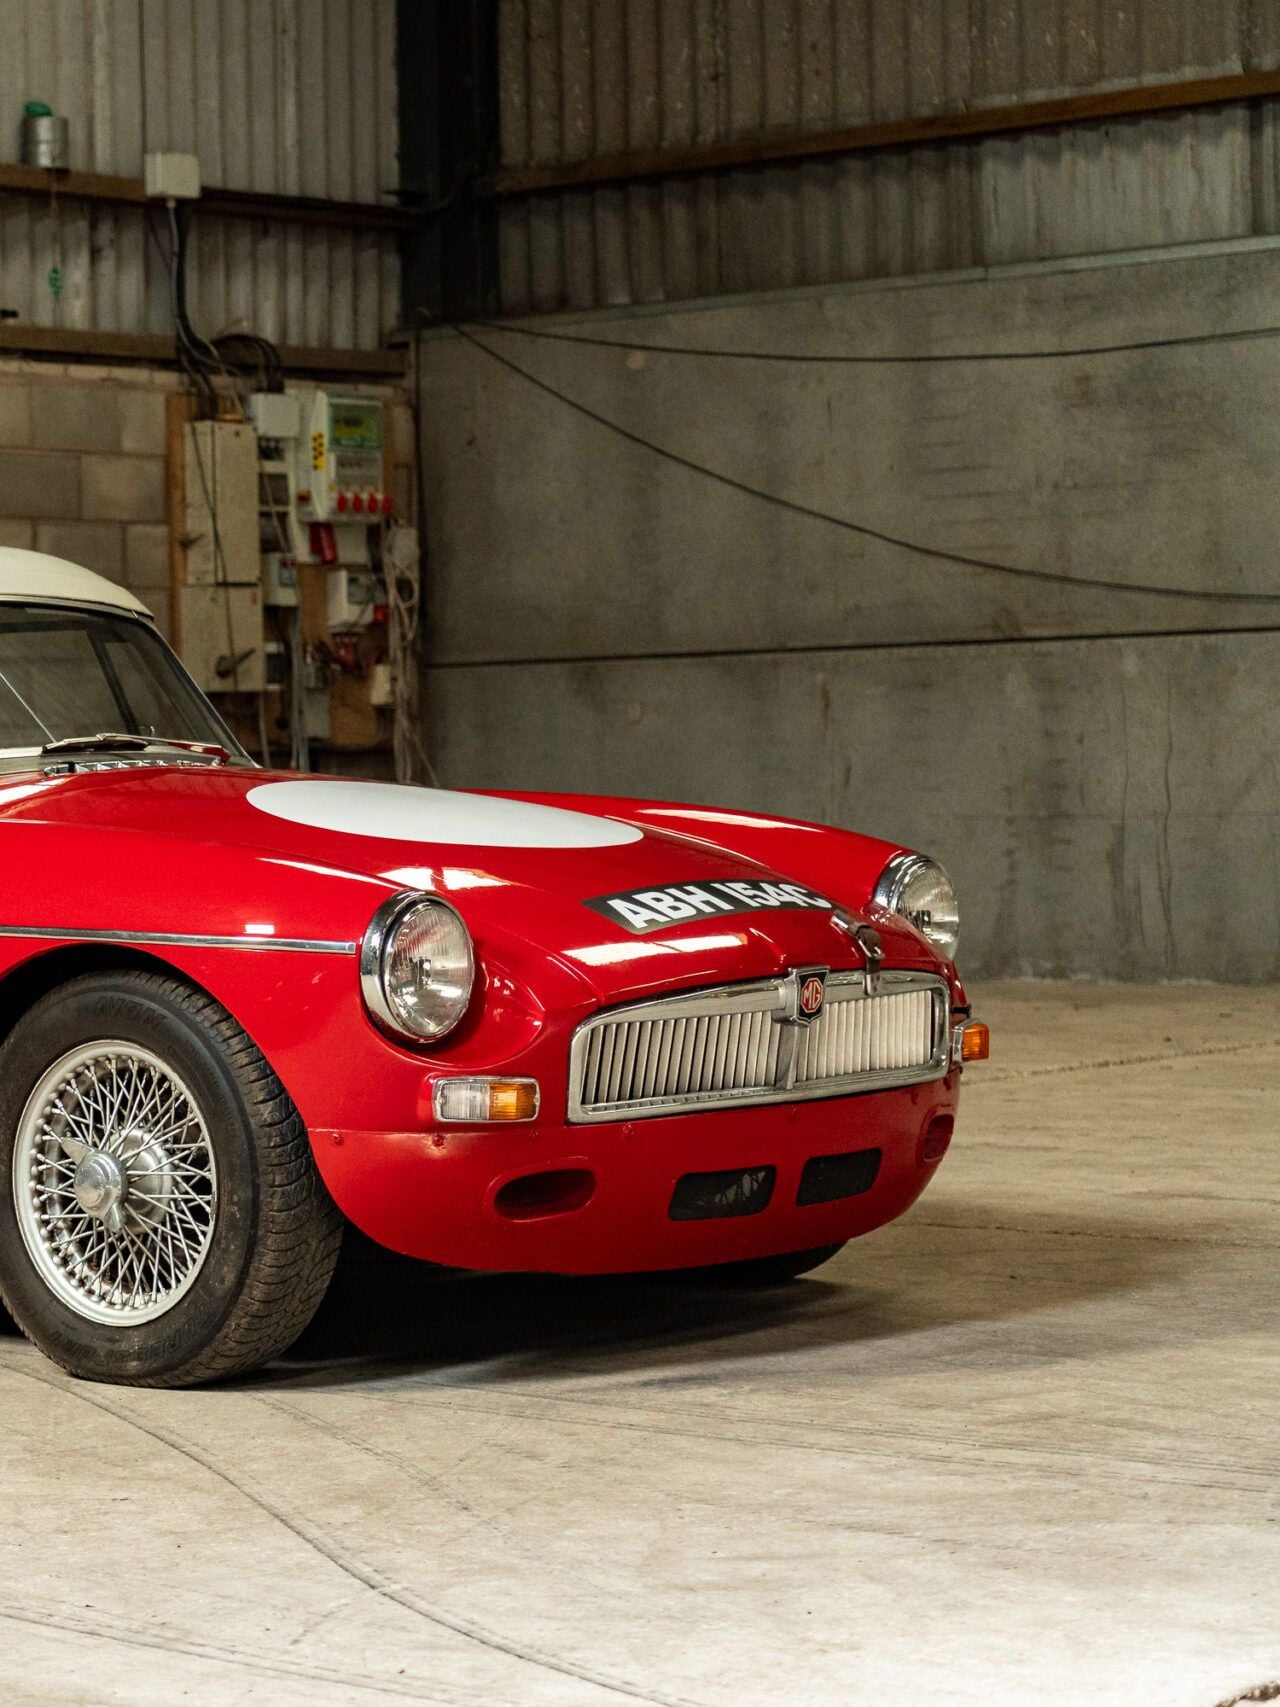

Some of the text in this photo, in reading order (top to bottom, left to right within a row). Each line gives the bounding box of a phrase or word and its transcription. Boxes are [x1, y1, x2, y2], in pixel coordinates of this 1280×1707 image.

[607, 883, 832, 929] ABH 154C
[803, 981, 821, 1009] MG
